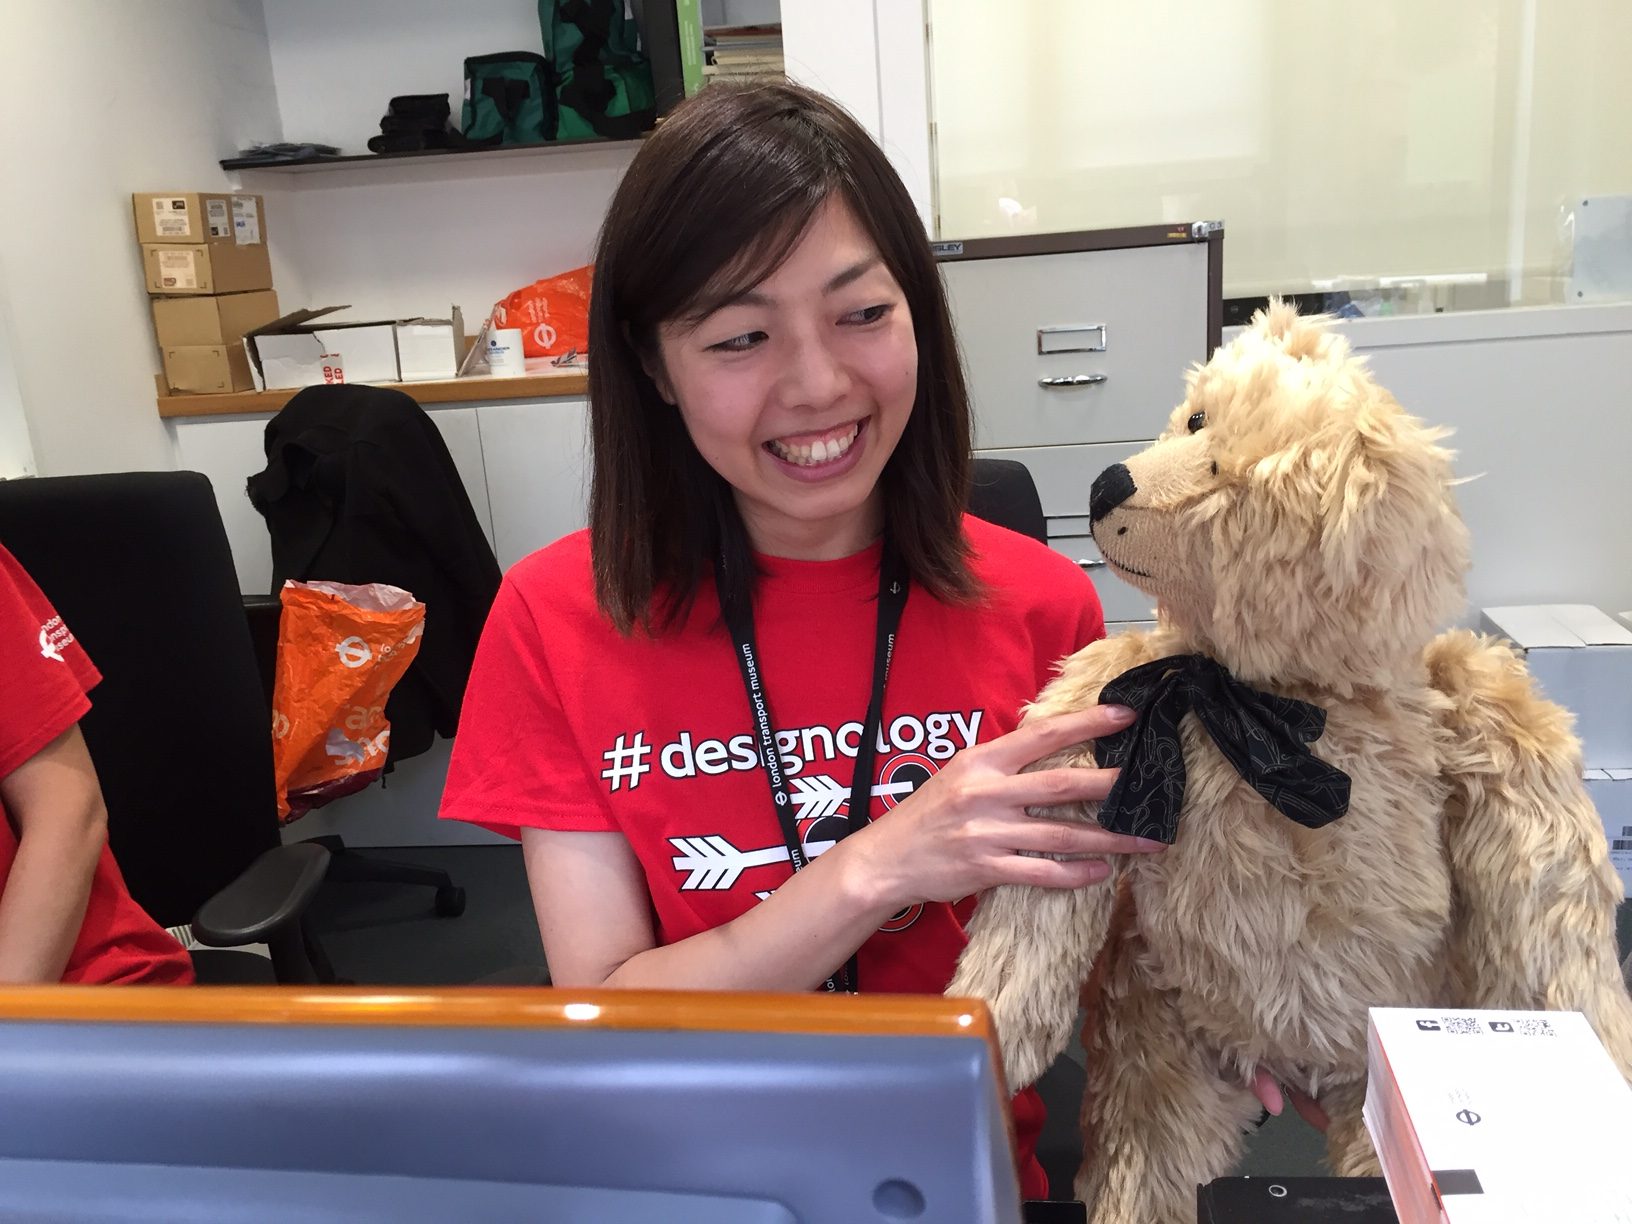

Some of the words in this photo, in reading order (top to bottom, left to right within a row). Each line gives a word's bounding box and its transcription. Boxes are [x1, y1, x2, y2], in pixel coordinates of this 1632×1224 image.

[323, 366, 334, 384] KED
[334, 367, 344, 384] LED
[742, 643, 760, 691] museum
[752, 692, 772, 746] transport
[765, 748, 783, 788] london
